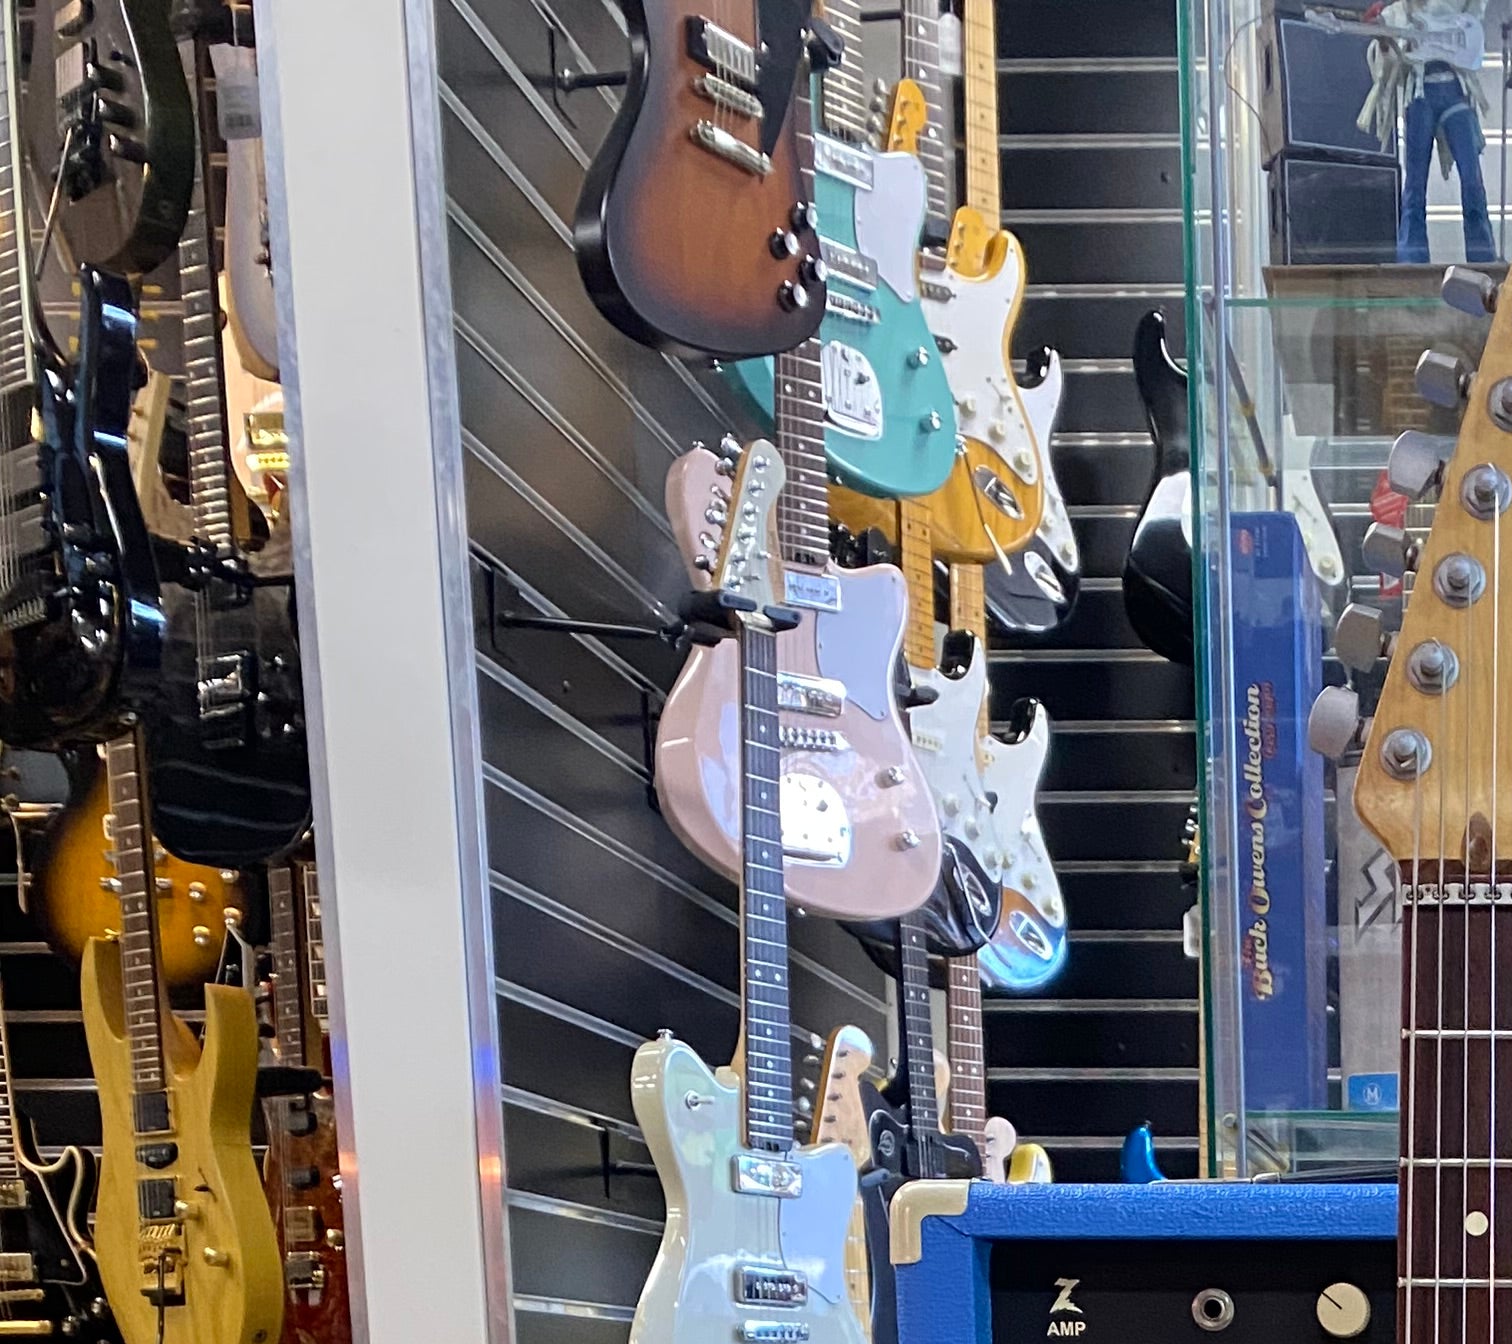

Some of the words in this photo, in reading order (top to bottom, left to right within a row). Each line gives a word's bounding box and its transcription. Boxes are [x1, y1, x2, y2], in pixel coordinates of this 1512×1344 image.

[1243, 683, 1268, 819] Collection
[1249, 821, 1270, 915] Owens
[1248, 918, 1273, 1000] Buck
[1047, 1321, 1086, 1336] AMP
